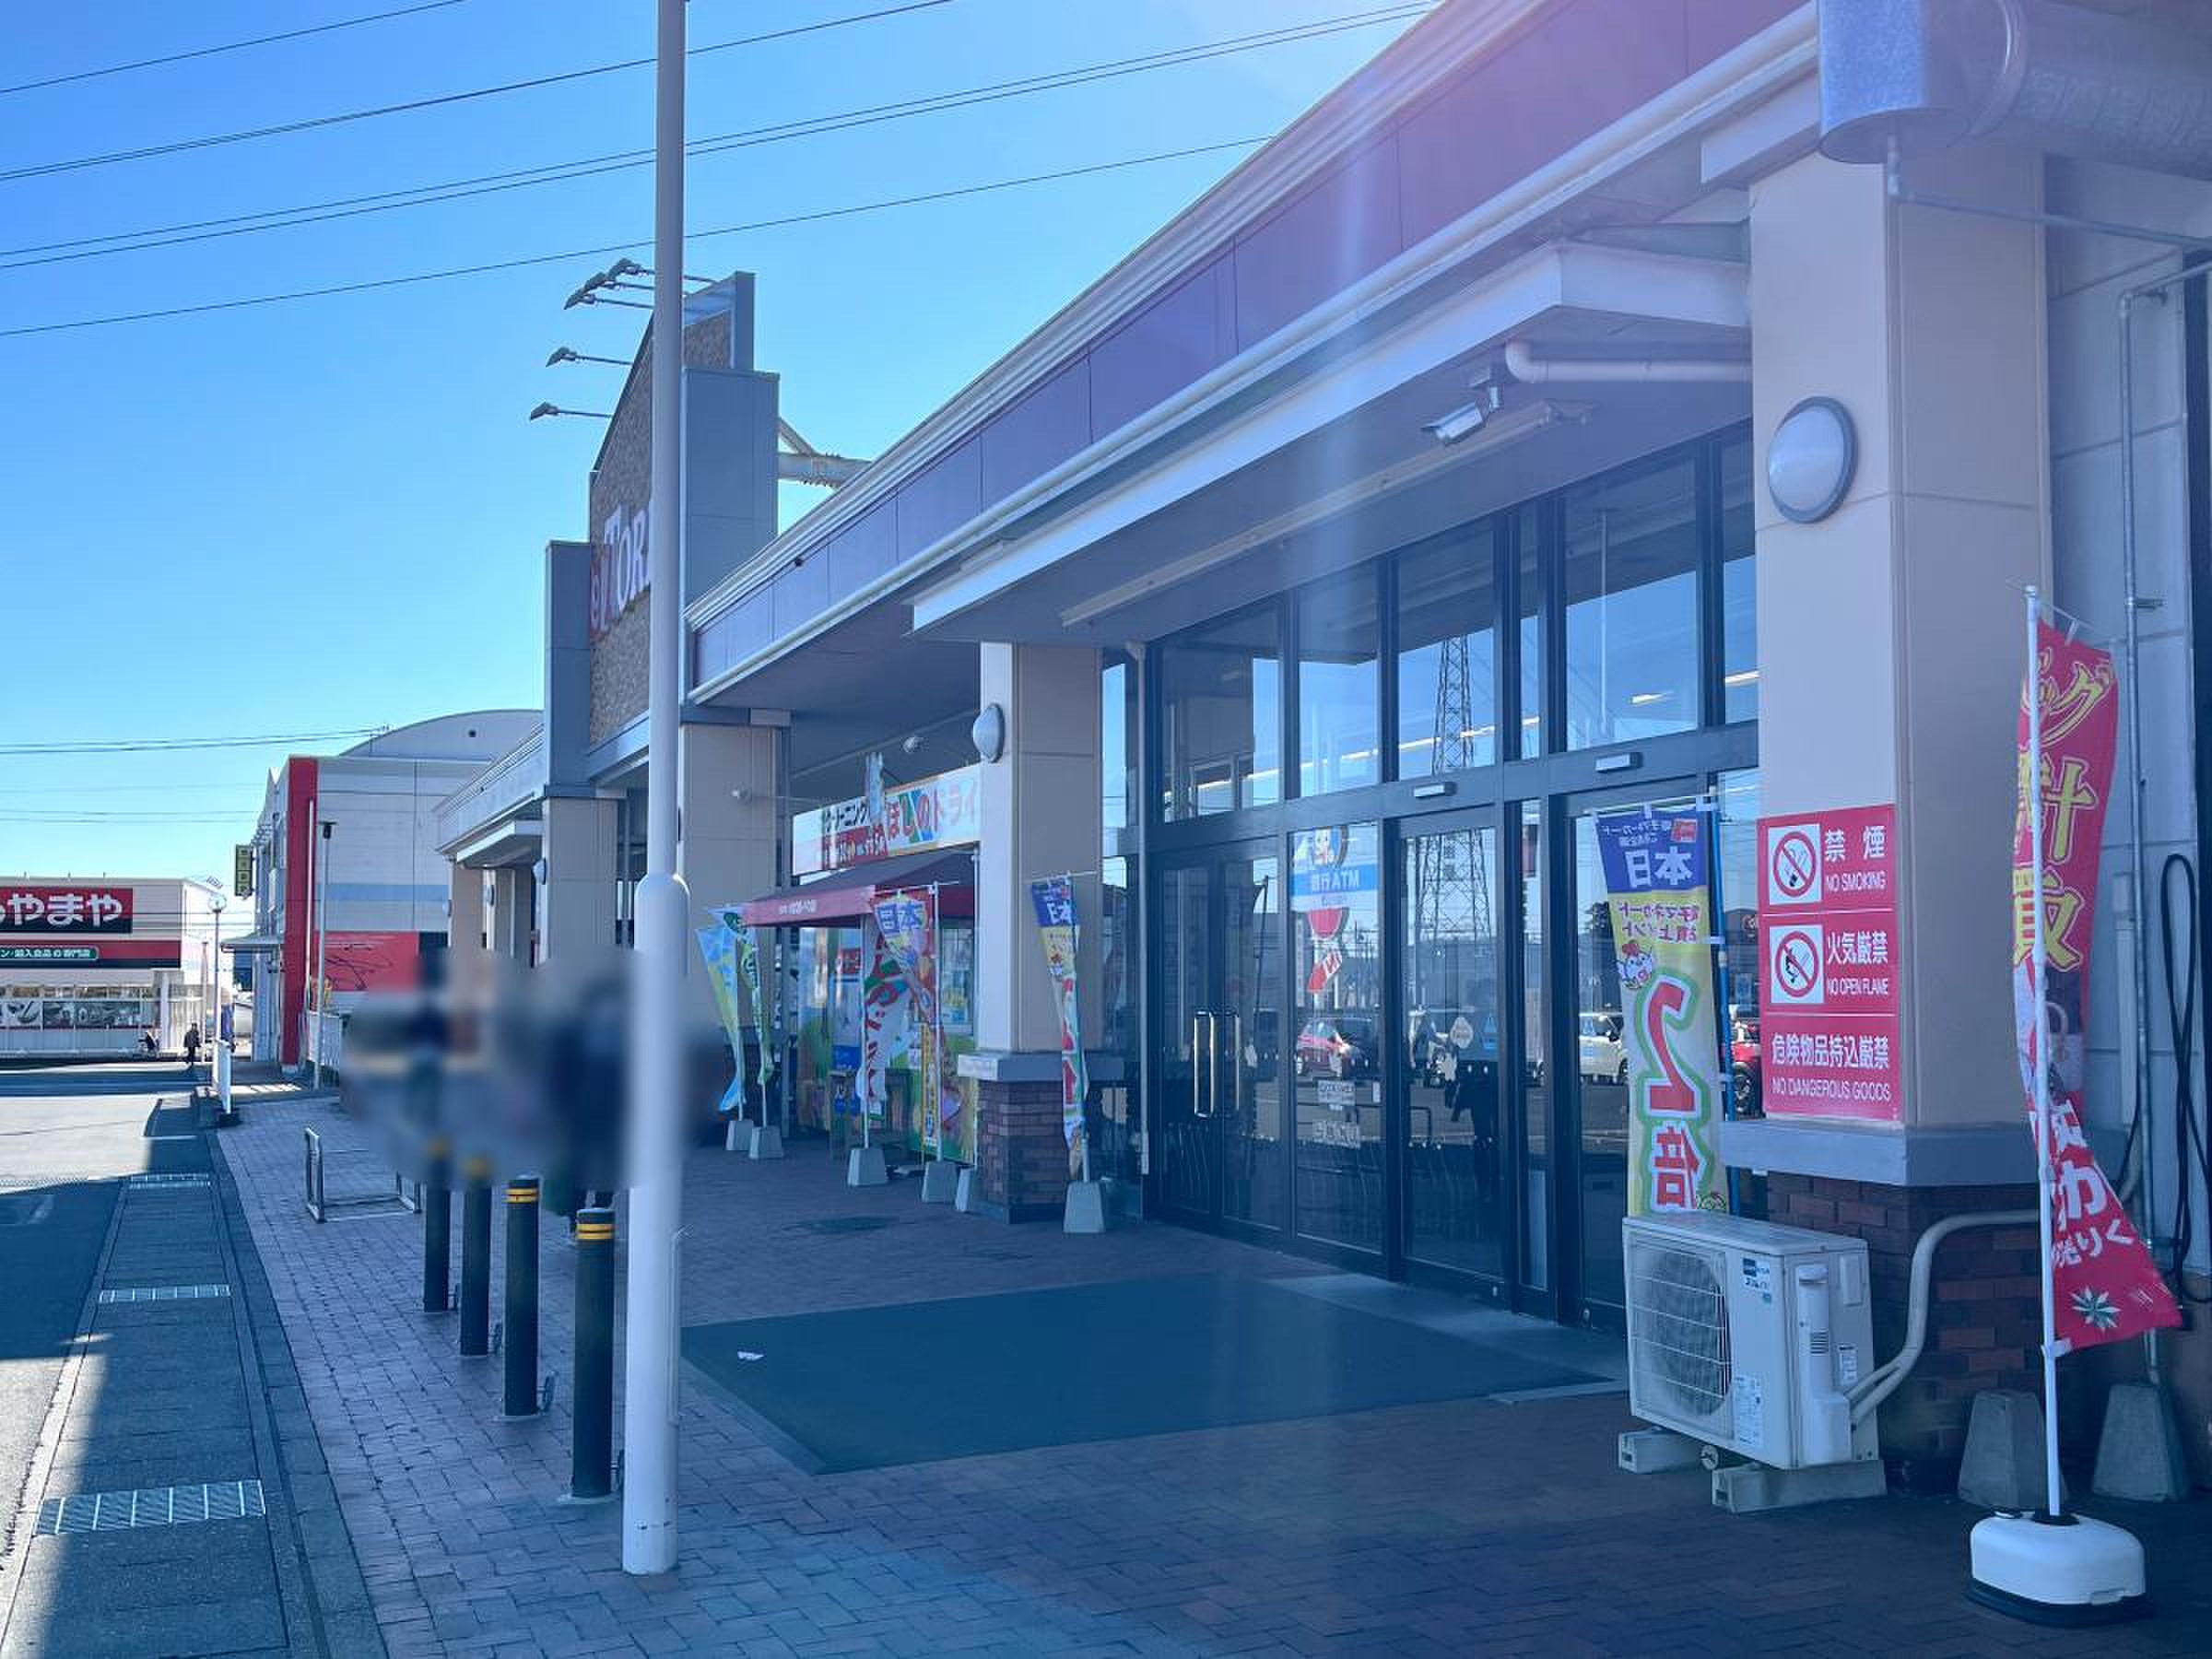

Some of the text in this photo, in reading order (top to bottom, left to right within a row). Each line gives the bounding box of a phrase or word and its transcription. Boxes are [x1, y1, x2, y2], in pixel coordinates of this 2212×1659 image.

[1825, 826, 1887, 865] 禁煙
[1829, 870, 1887, 893] NO SMOKING
[0, 893, 123, 927] やまや
[1828, 931, 1888, 966] 火気厳禁
[1828, 977, 1888, 995] NO OPEN FLAME
[1771, 1033, 1888, 1070] 危険物品持込厳禁
[1772, 1077, 1892, 1102] NO DANGEROUS GOODS
